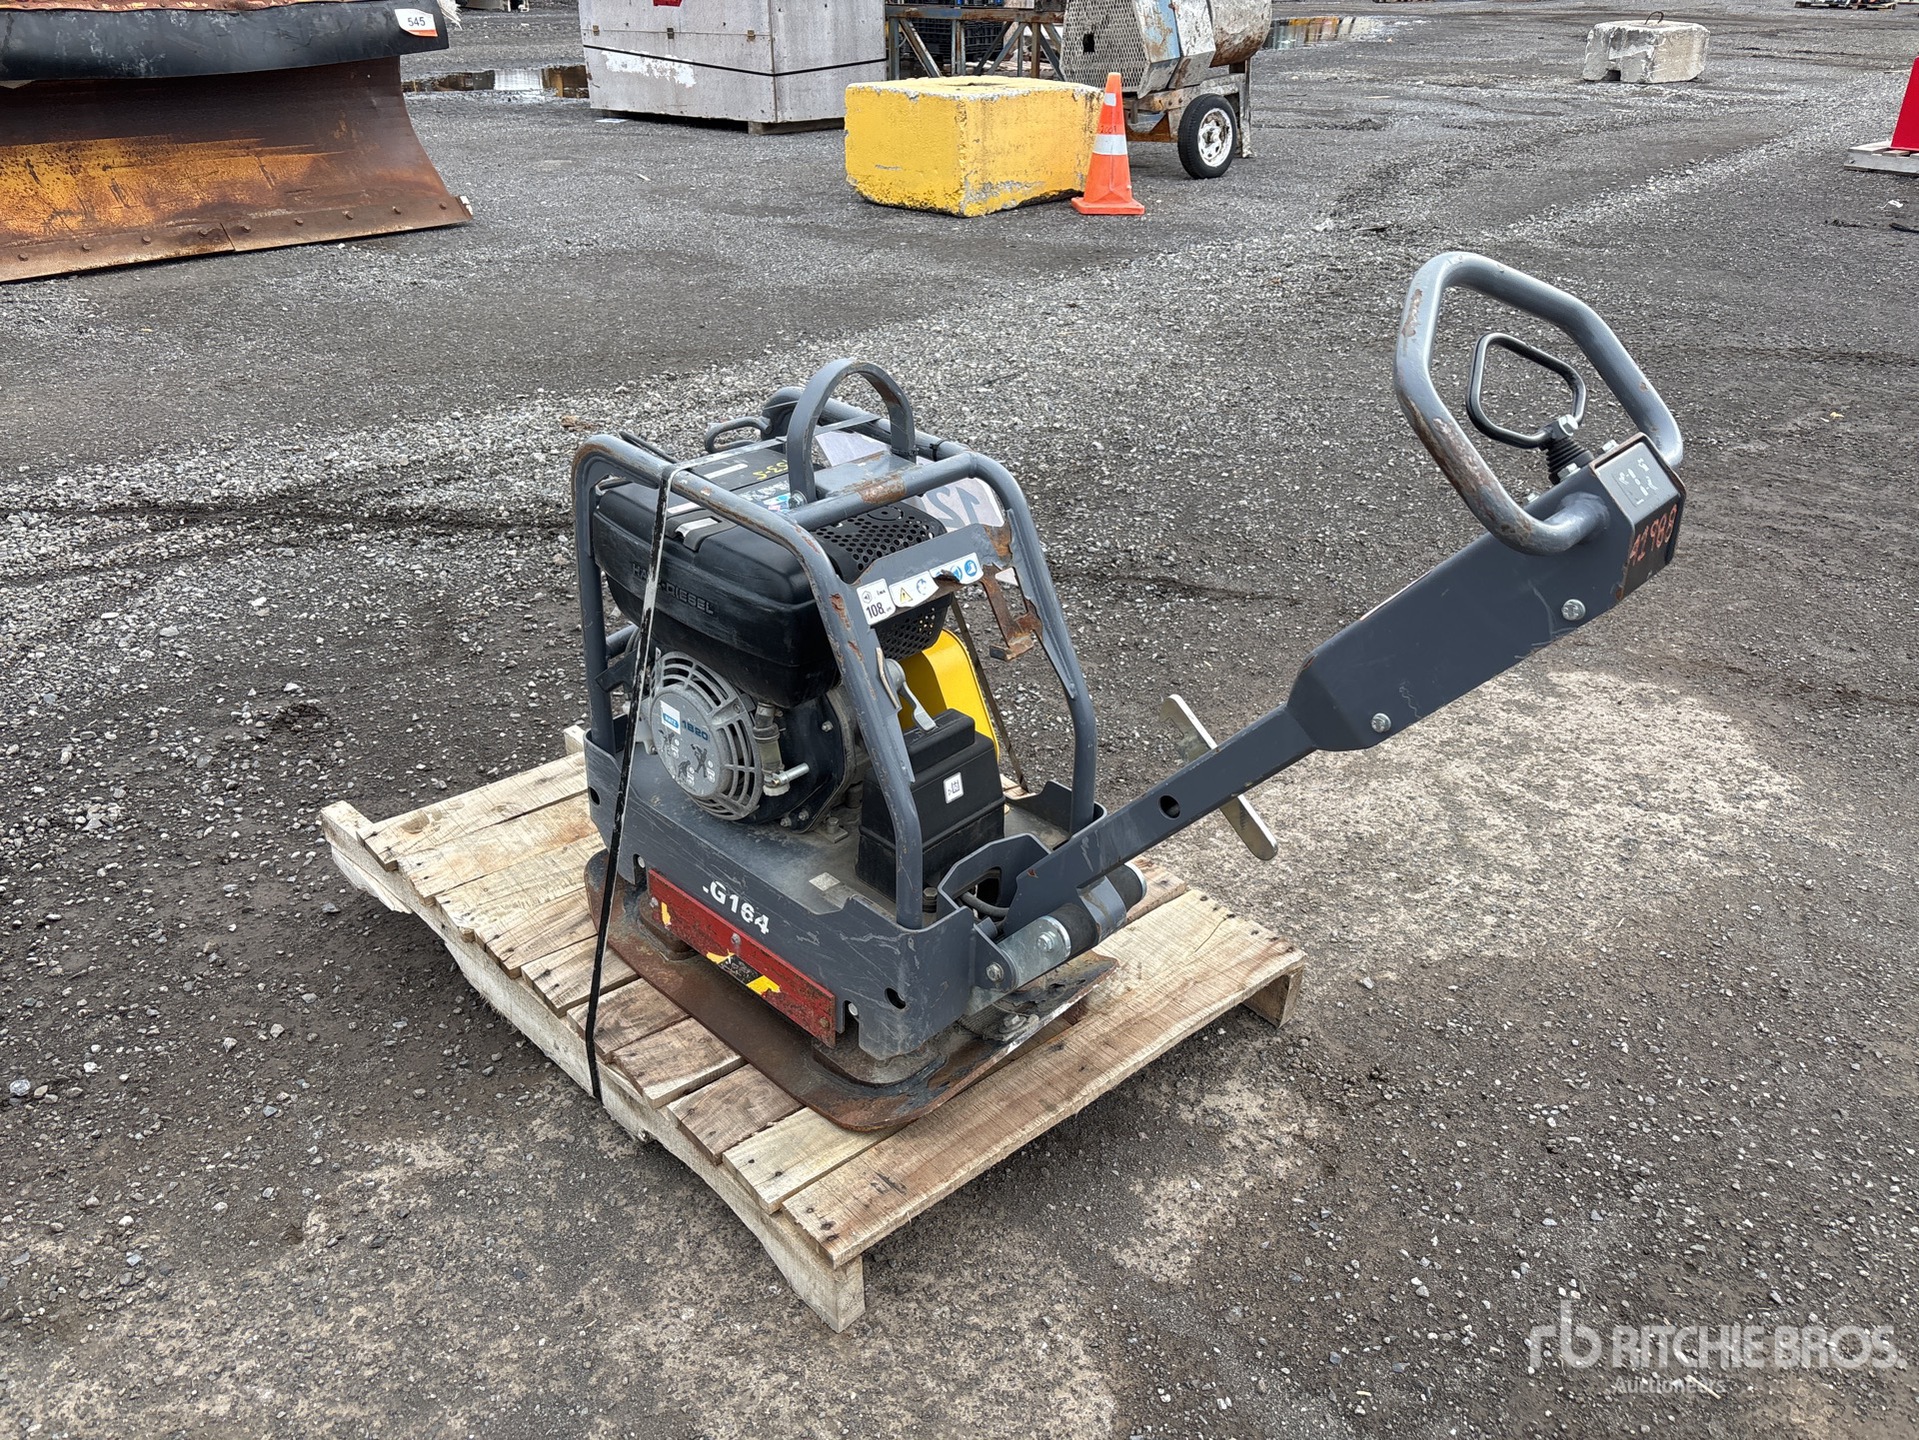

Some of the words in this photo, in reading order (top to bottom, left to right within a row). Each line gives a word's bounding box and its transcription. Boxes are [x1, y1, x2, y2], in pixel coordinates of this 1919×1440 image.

[407, 16, 426, 27] 545
[865, 602, 885, 619] 108
[682, 720, 709, 742] 1B20
[702, 881, 769, 935] G164
